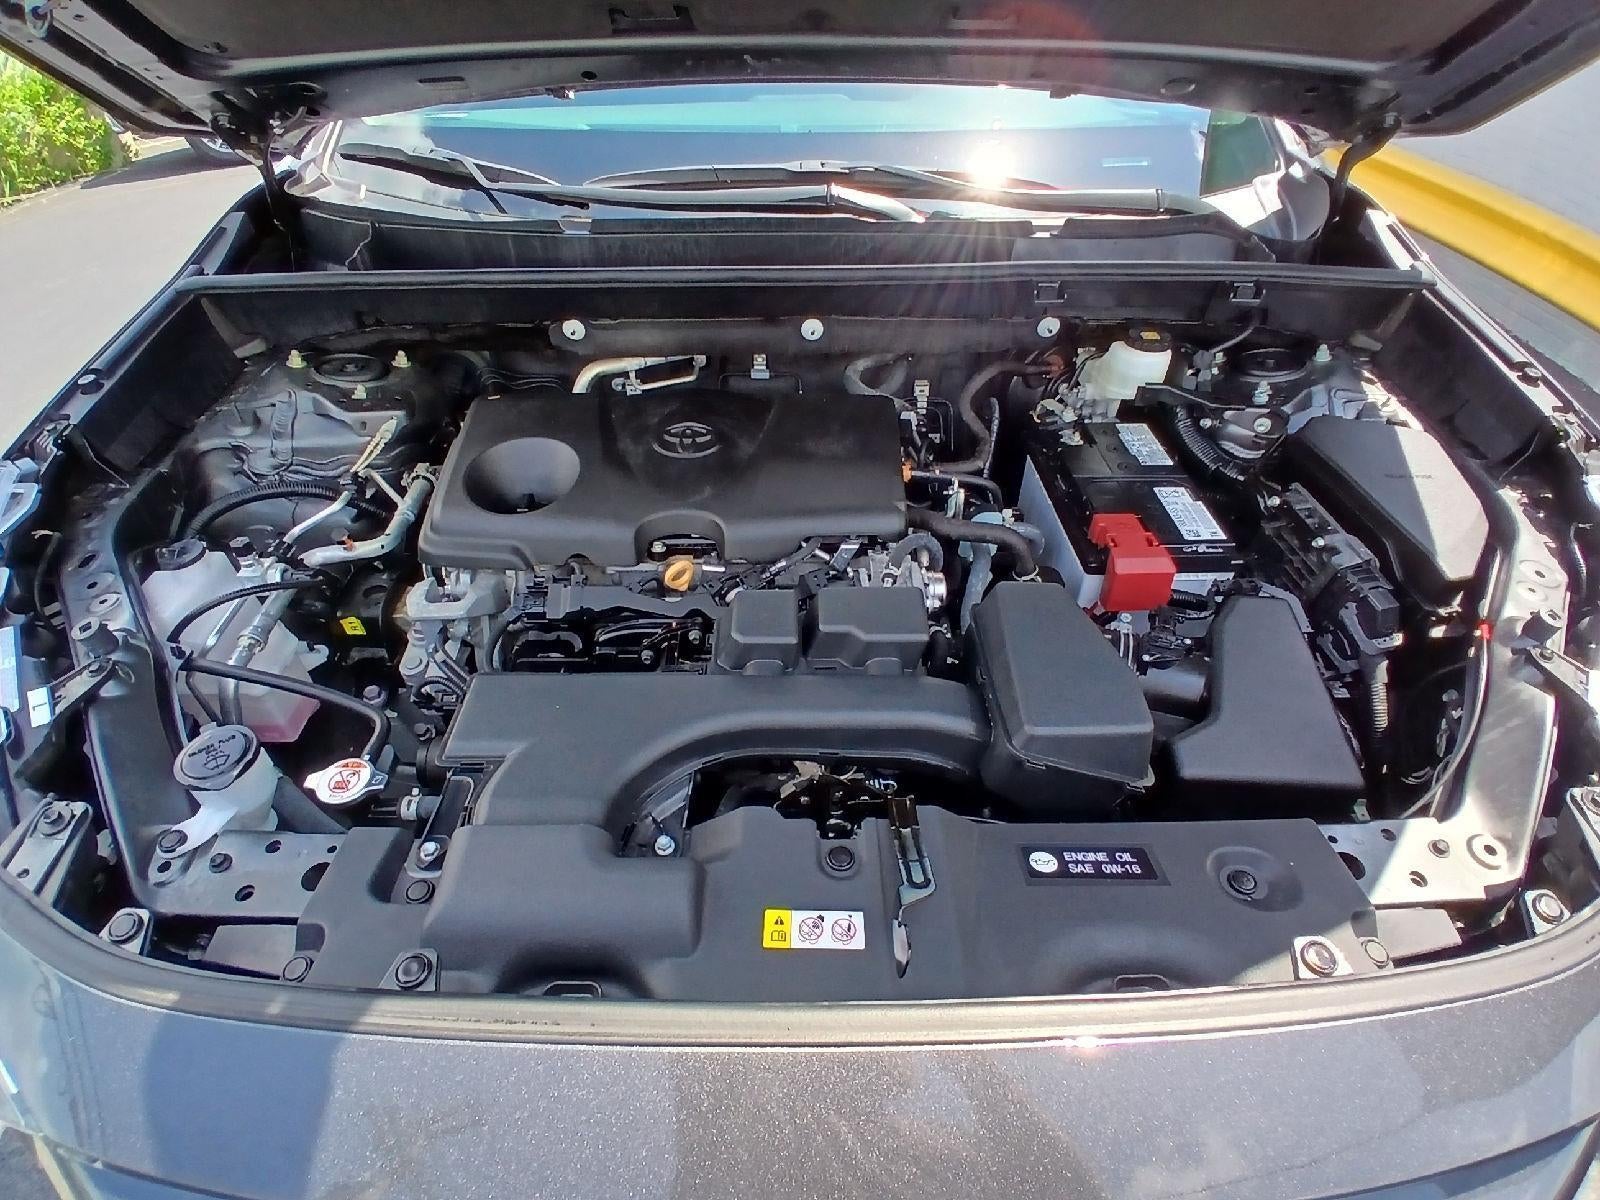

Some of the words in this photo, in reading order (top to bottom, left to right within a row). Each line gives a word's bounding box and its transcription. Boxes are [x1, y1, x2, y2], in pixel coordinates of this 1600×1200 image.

[1063, 851, 1109, 862] ENGINE
[1115, 852, 1137, 862] OIL
[1068, 863, 1095, 874] SAE
[1101, 864, 1142, 874] 0W-16
